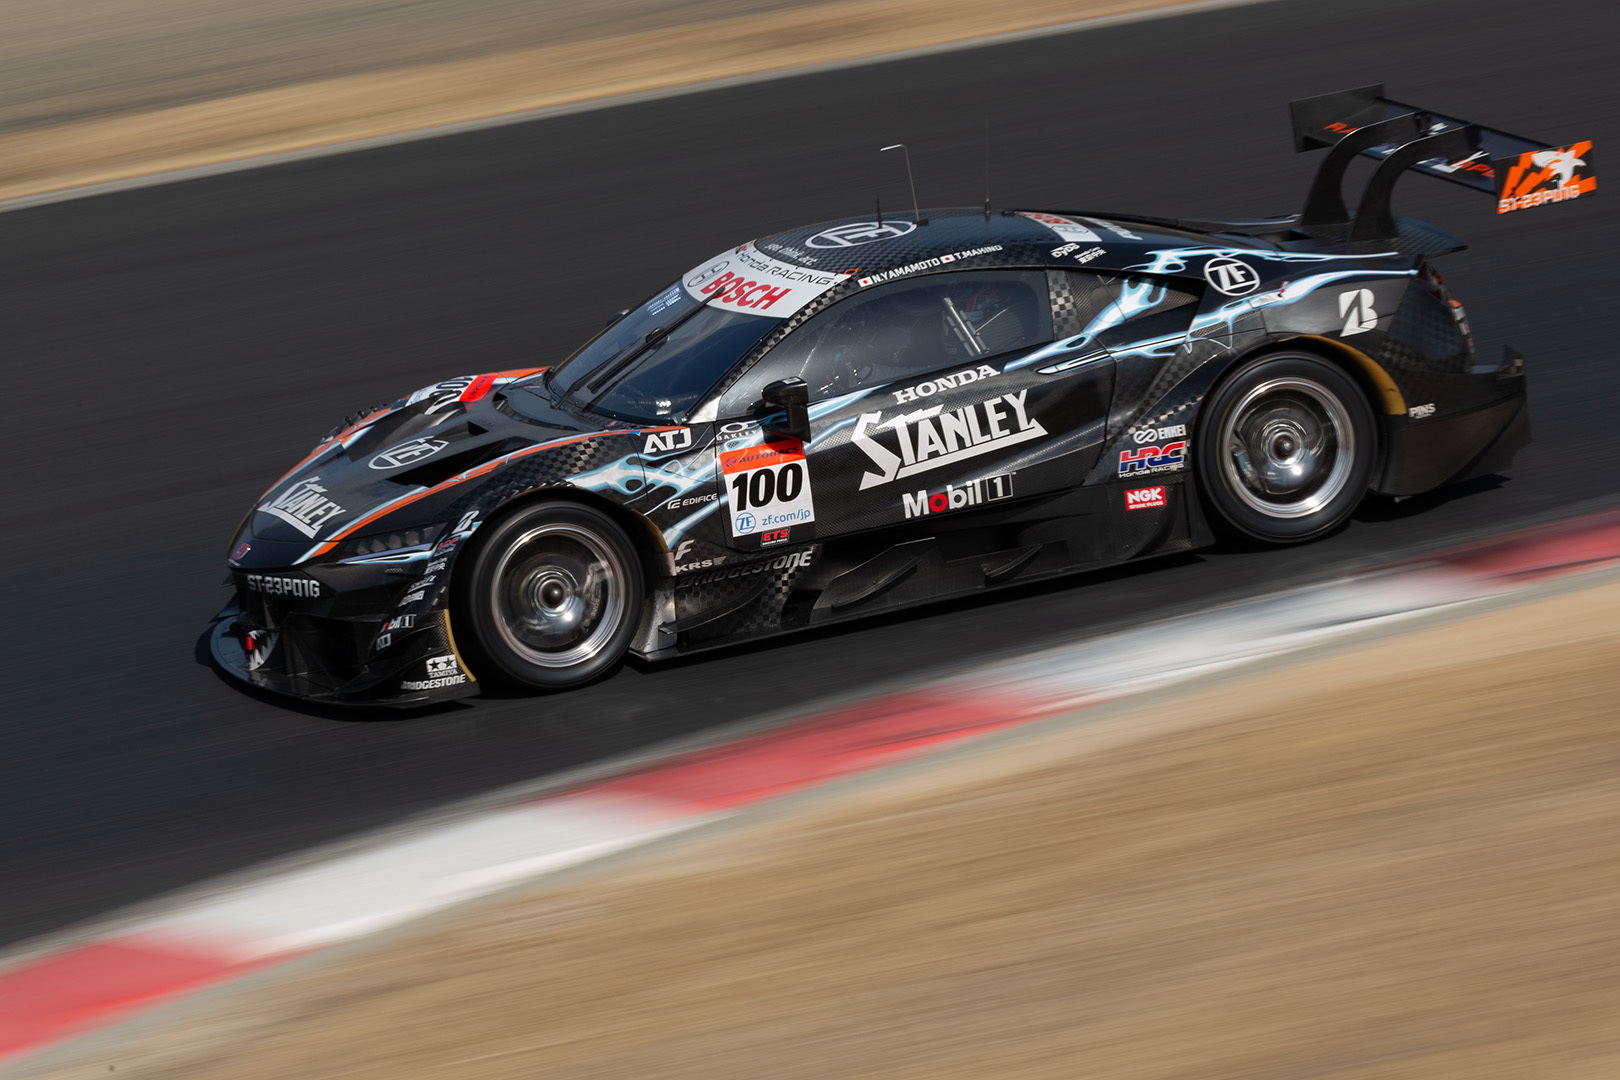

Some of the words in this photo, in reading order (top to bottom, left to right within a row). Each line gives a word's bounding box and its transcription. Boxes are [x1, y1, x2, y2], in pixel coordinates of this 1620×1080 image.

[953, 244, 1003, 260] T.MAKINO
[766, 265, 834, 286] RACING
[872, 258, 940, 283] N.YAMAMOTO
[1207, 260, 1258, 293] ZF
[700, 271, 792, 310] BOSCH
[892, 365, 1000, 404] HONDA
[1408, 402, 1436, 418] PINS
[643, 427, 692, 454] ATJ
[716, 429, 757, 441] OAKLEY
[850, 390, 1048, 491] STANLEY
[1158, 424, 1187, 440] ENKEI
[739, 446, 800, 464] AUTOBACS
[1118, 441, 1186, 474] HRC
[732, 463, 803, 512] 100
[902, 478, 982, 519] Mobil
[1127, 487, 1162, 504] NGK
[257, 475, 347, 540] STANLEY
[682, 493, 718, 506] EDIFICE
[736, 513, 756, 533] ZF
[762, 508, 811, 526] zf.com/jp
[763, 528, 789, 542] ETS
[400, 674, 466, 691] BRIDGESTONE
[428, 668, 459, 679] TAMIYA
